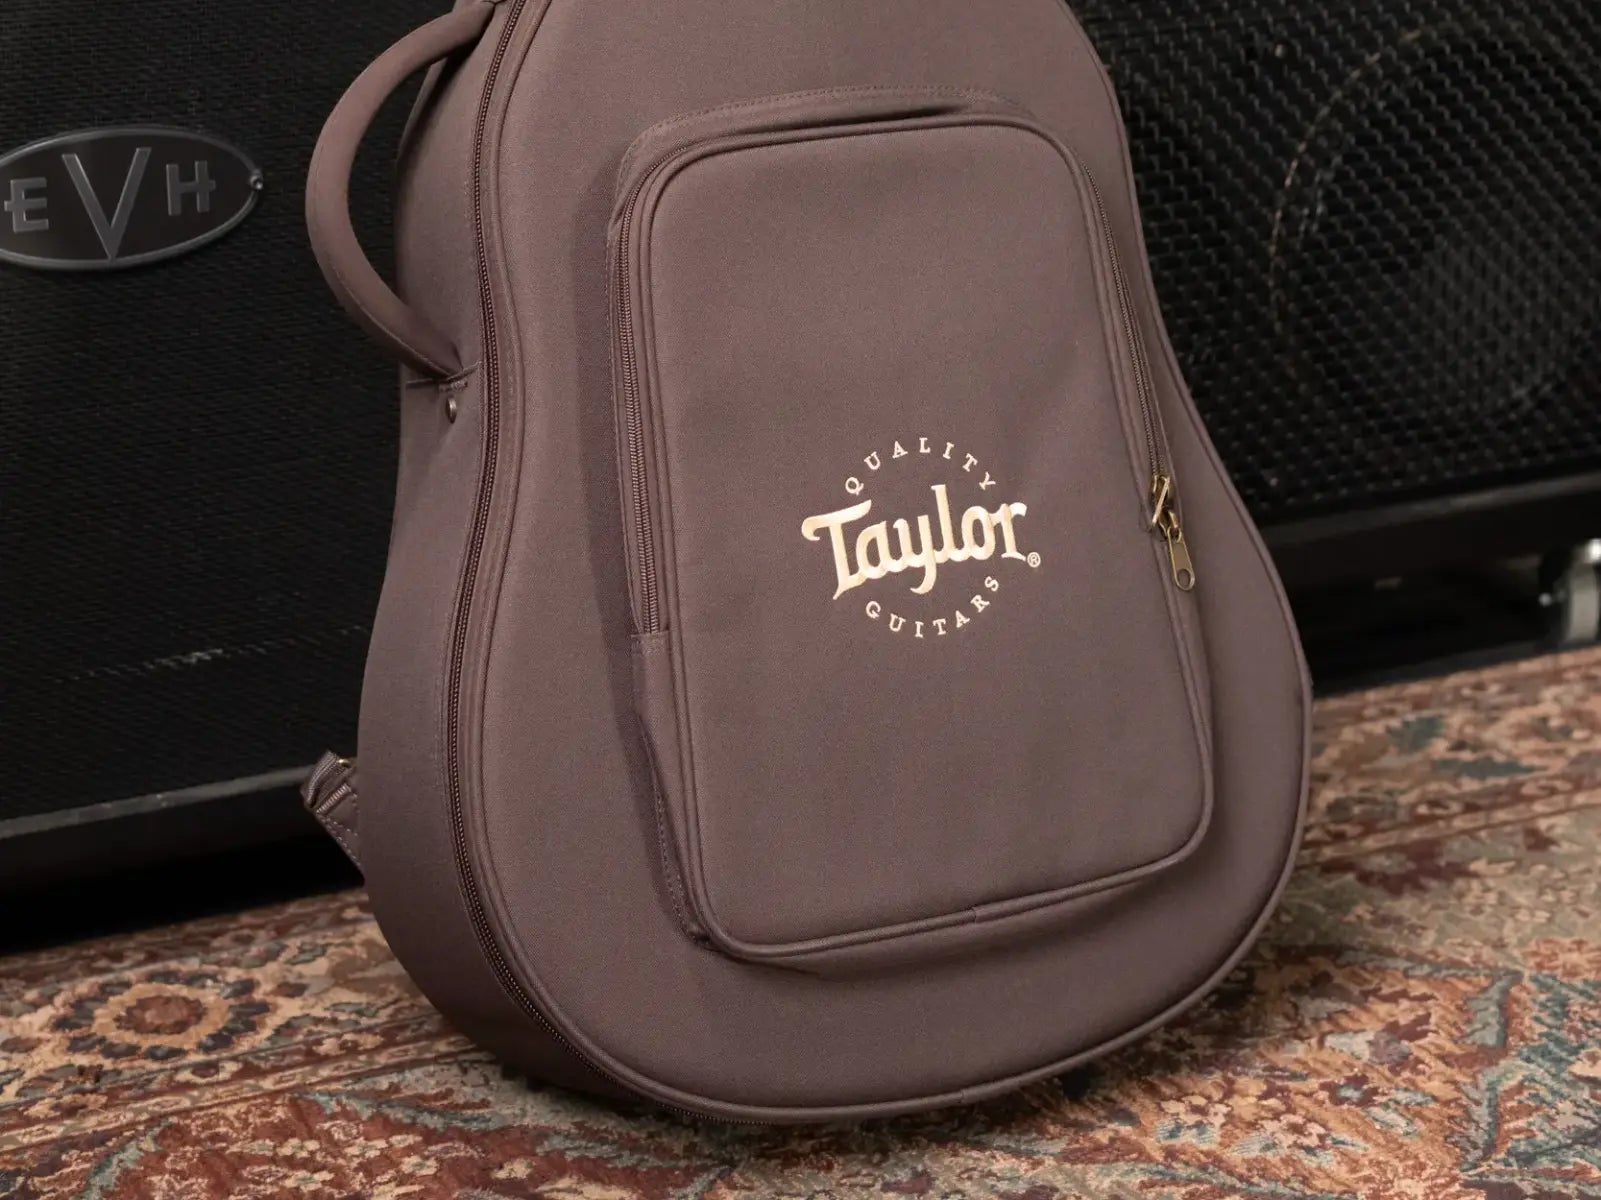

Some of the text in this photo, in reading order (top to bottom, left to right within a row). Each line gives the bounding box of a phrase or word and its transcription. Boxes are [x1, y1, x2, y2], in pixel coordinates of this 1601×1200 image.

[4, 147, 216, 264] EVH
[845, 437, 996, 496] QUALITY
[865, 576, 1000, 639] GUITARS
